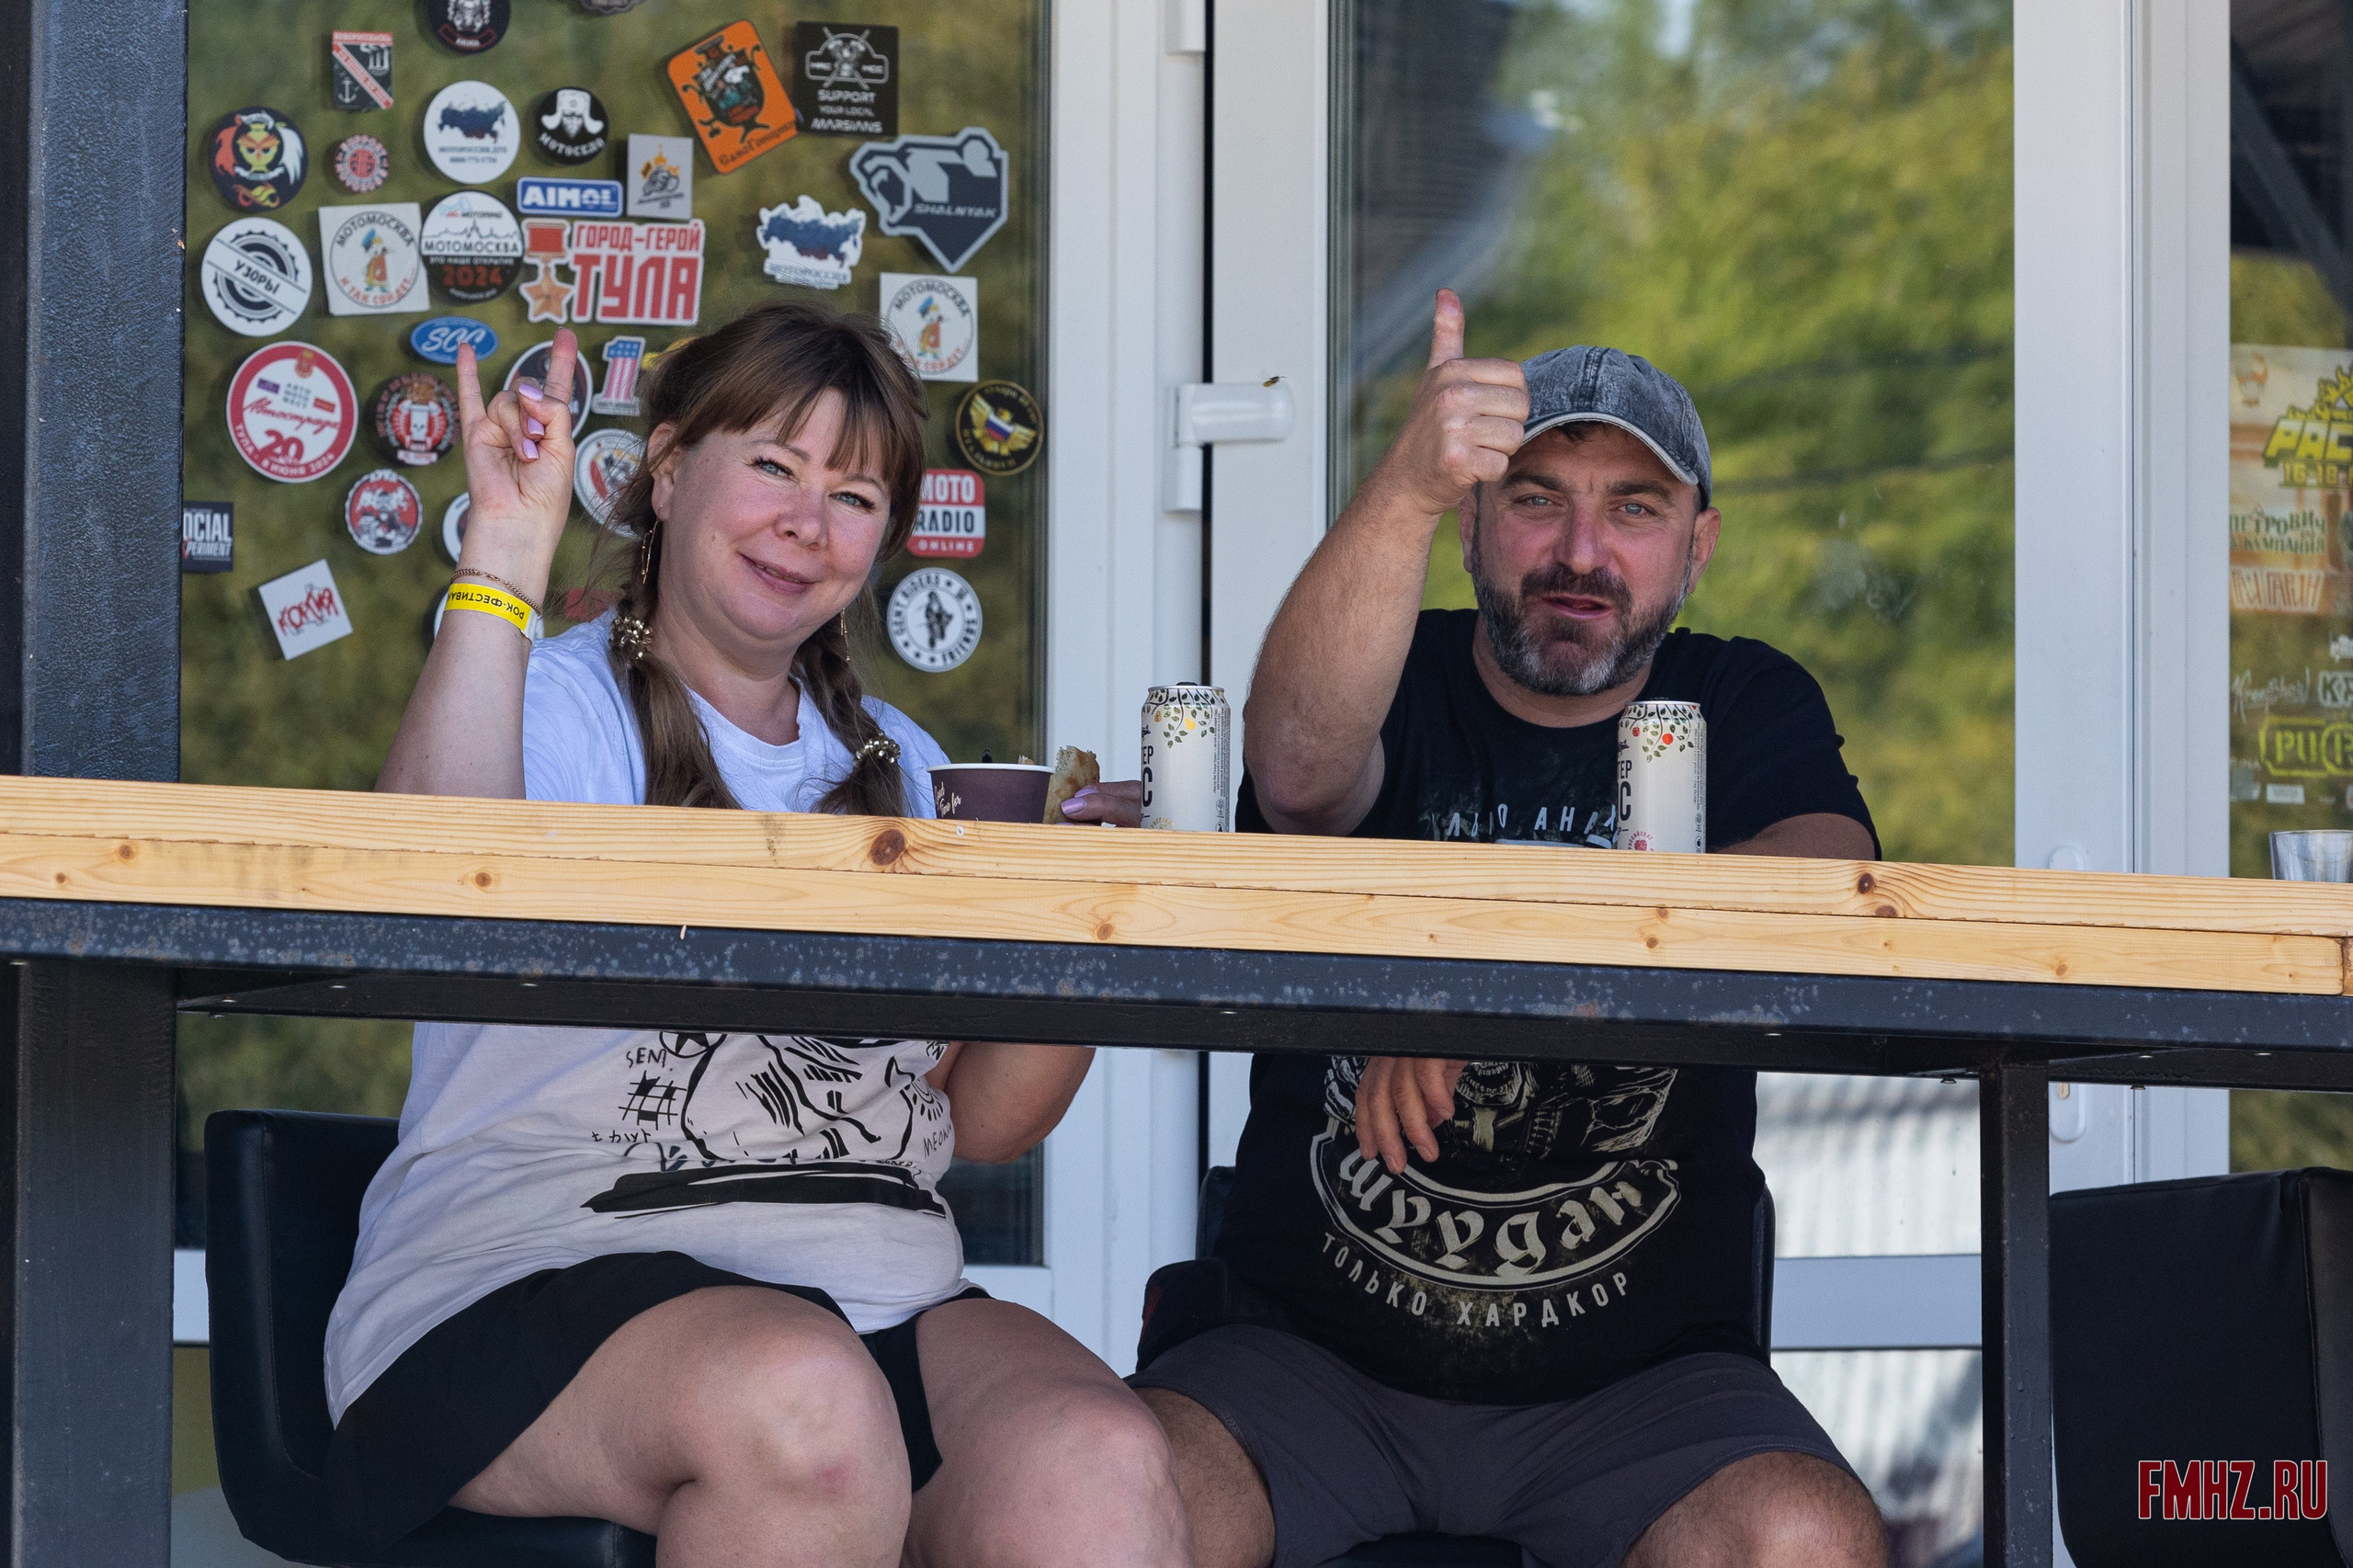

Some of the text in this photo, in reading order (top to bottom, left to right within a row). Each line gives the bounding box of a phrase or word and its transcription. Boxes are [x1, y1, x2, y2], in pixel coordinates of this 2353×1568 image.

[817, 89, 876, 103] SUPPORT
[522, 185, 613, 208] AIMOL
[336, 212, 415, 247] МОТОМОСКВА
[576, 222, 701, 252] ГОРОД-ГЕРОЙ
[425, 240, 519, 253] МОТОМОСКВА
[233, 259, 279, 295] УЗОРЫ
[443, 265, 503, 287] 2024
[574, 254, 699, 321] ТУЛА
[894, 281, 971, 317] МОТОМОСКВА
[183, 511, 233, 542] OCIAL
[915, 510, 974, 533] RADIO
[918, 539, 974, 552] ONLINE
[1323, 1232, 1630, 1328] ТОЛЬКО ХАРДКОР
